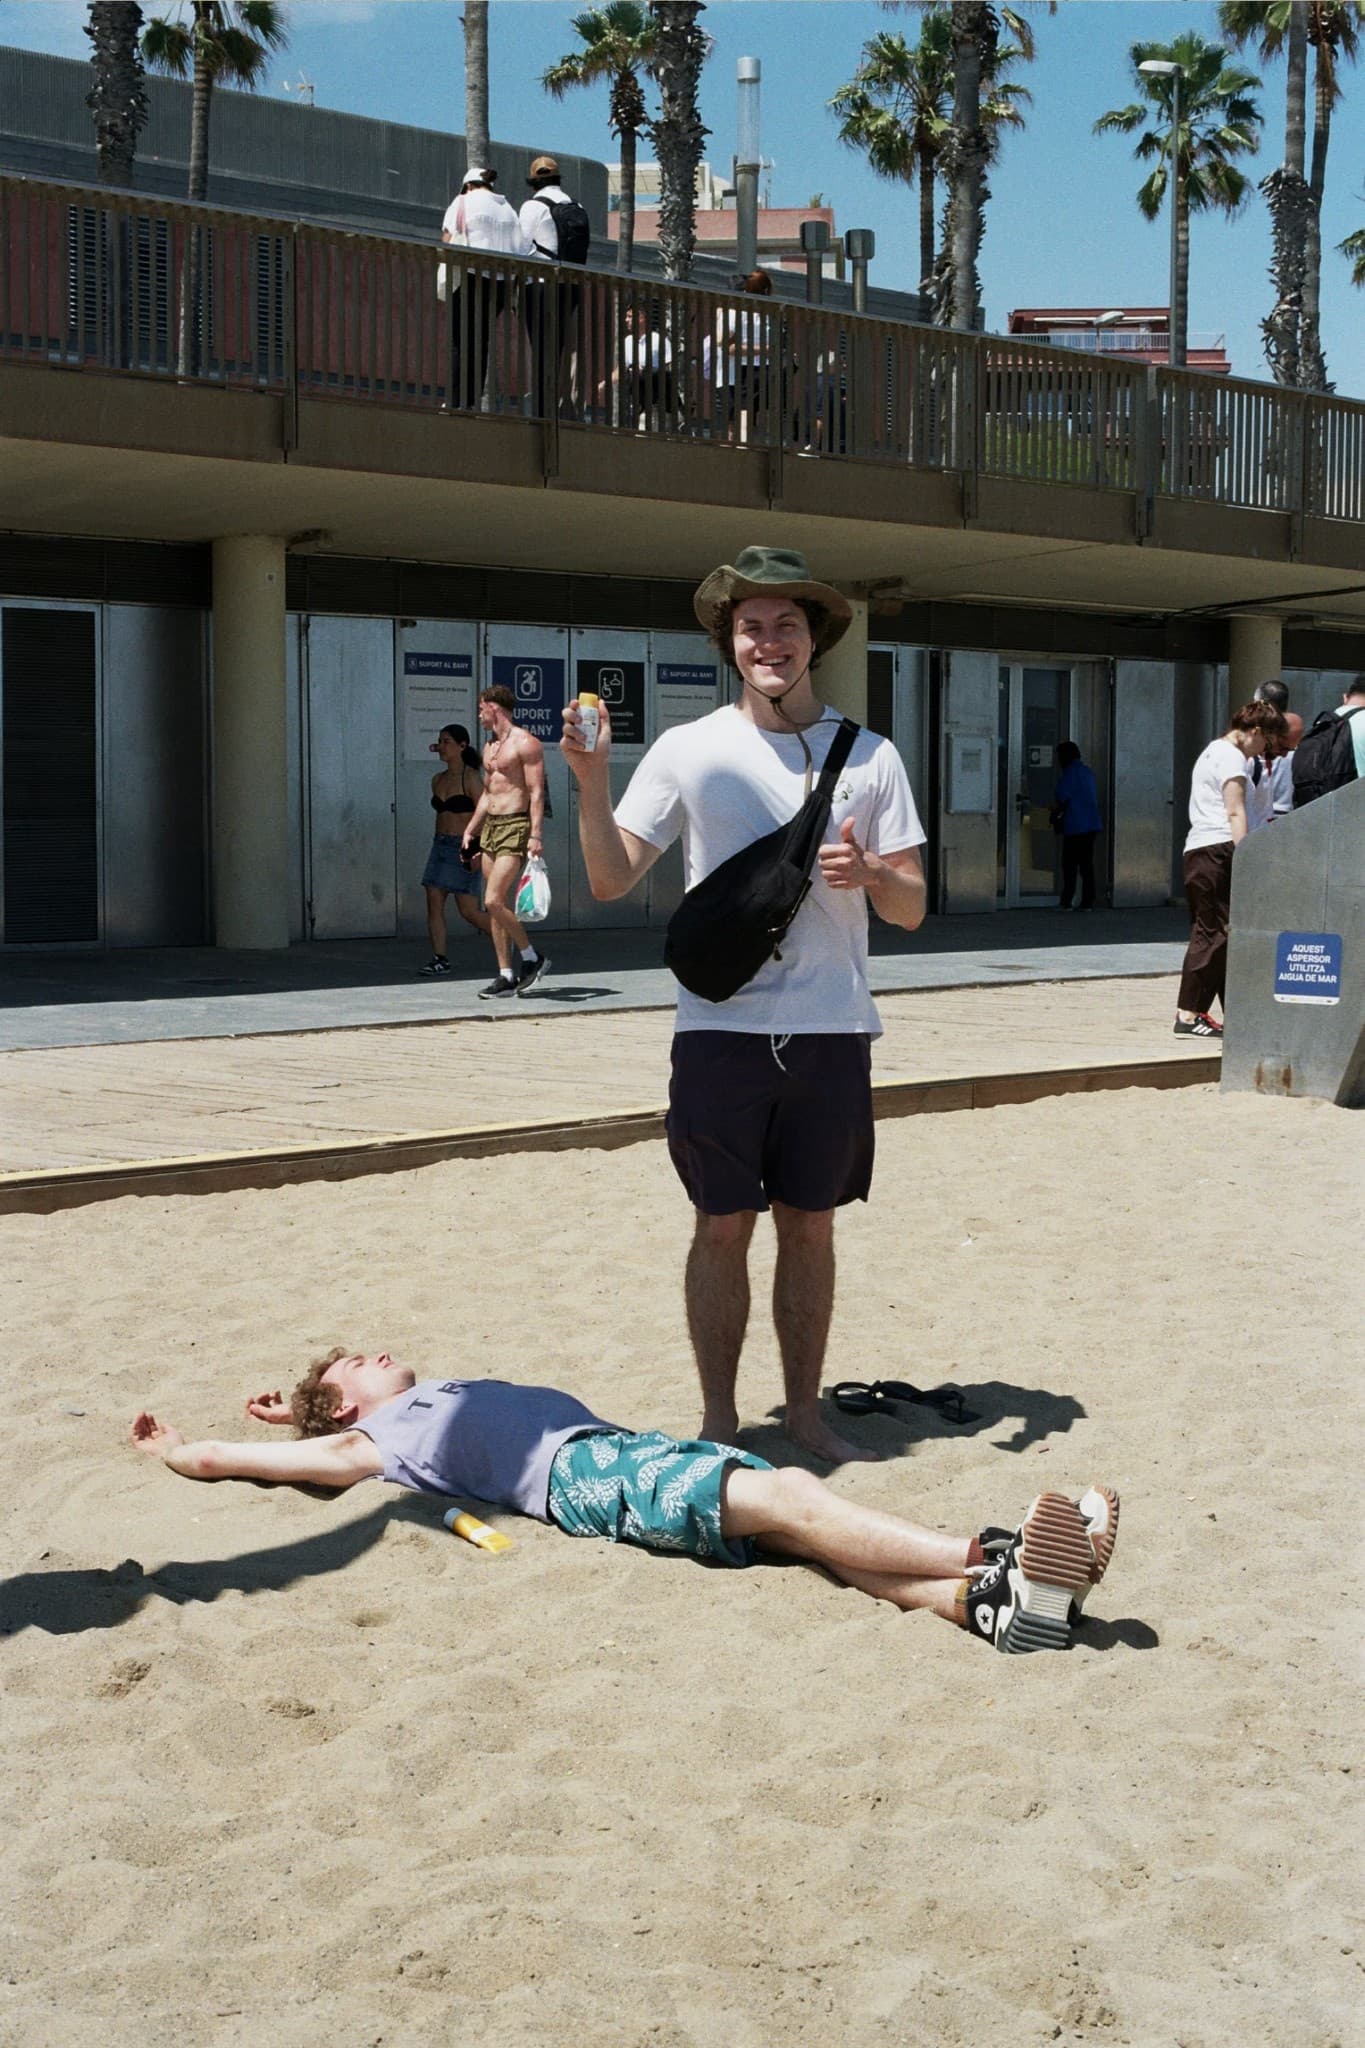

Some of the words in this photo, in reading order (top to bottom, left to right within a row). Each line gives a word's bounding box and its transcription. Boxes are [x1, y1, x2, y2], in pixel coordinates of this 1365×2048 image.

[513, 708, 552, 720] UPORT
[1292, 944, 1325, 954] AQUEST
[1286, 953, 1331, 964] ASPERSOR
[1289, 963, 1326, 973] UTILITZA
[1278, 972, 1304, 982] AIGUA
[1305, 973, 1317, 983] DE
[1318, 974, 1338, 984] MAR
